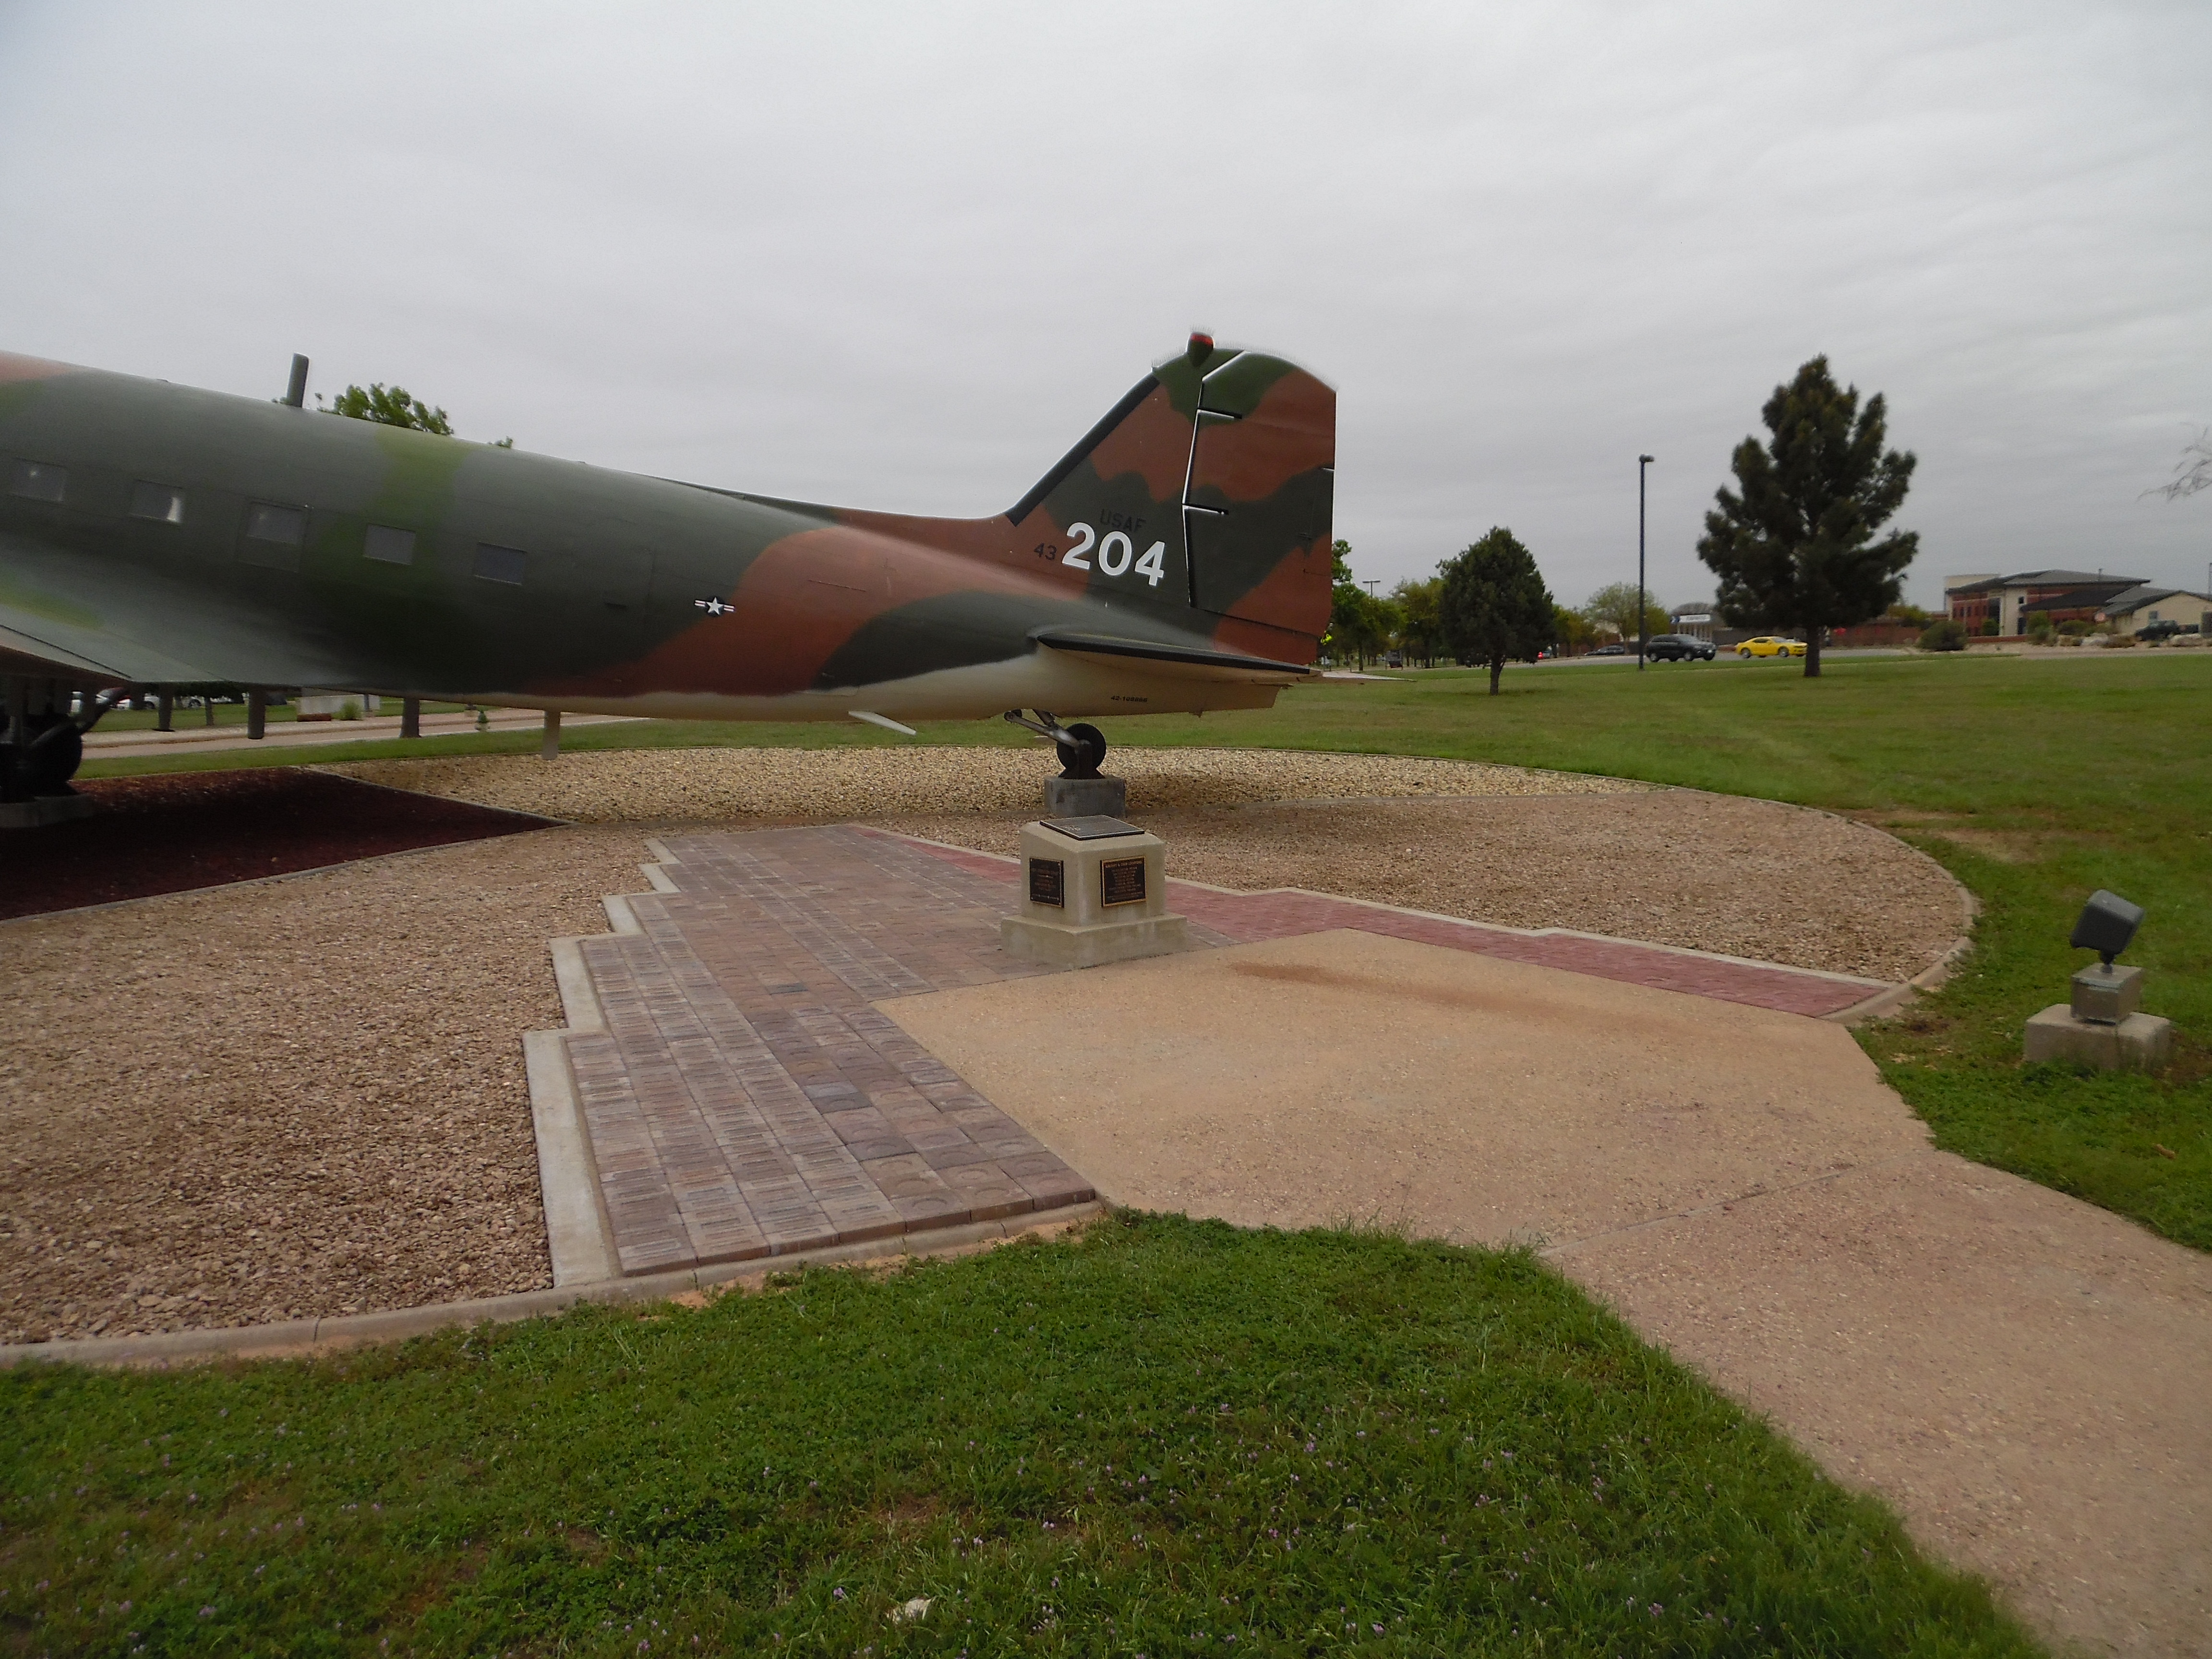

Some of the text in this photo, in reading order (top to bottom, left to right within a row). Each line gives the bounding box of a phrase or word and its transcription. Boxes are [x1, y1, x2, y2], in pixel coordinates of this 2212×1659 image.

[1099, 508, 1146, 532] USAF
[1034, 522, 1165, 586] 43 204
